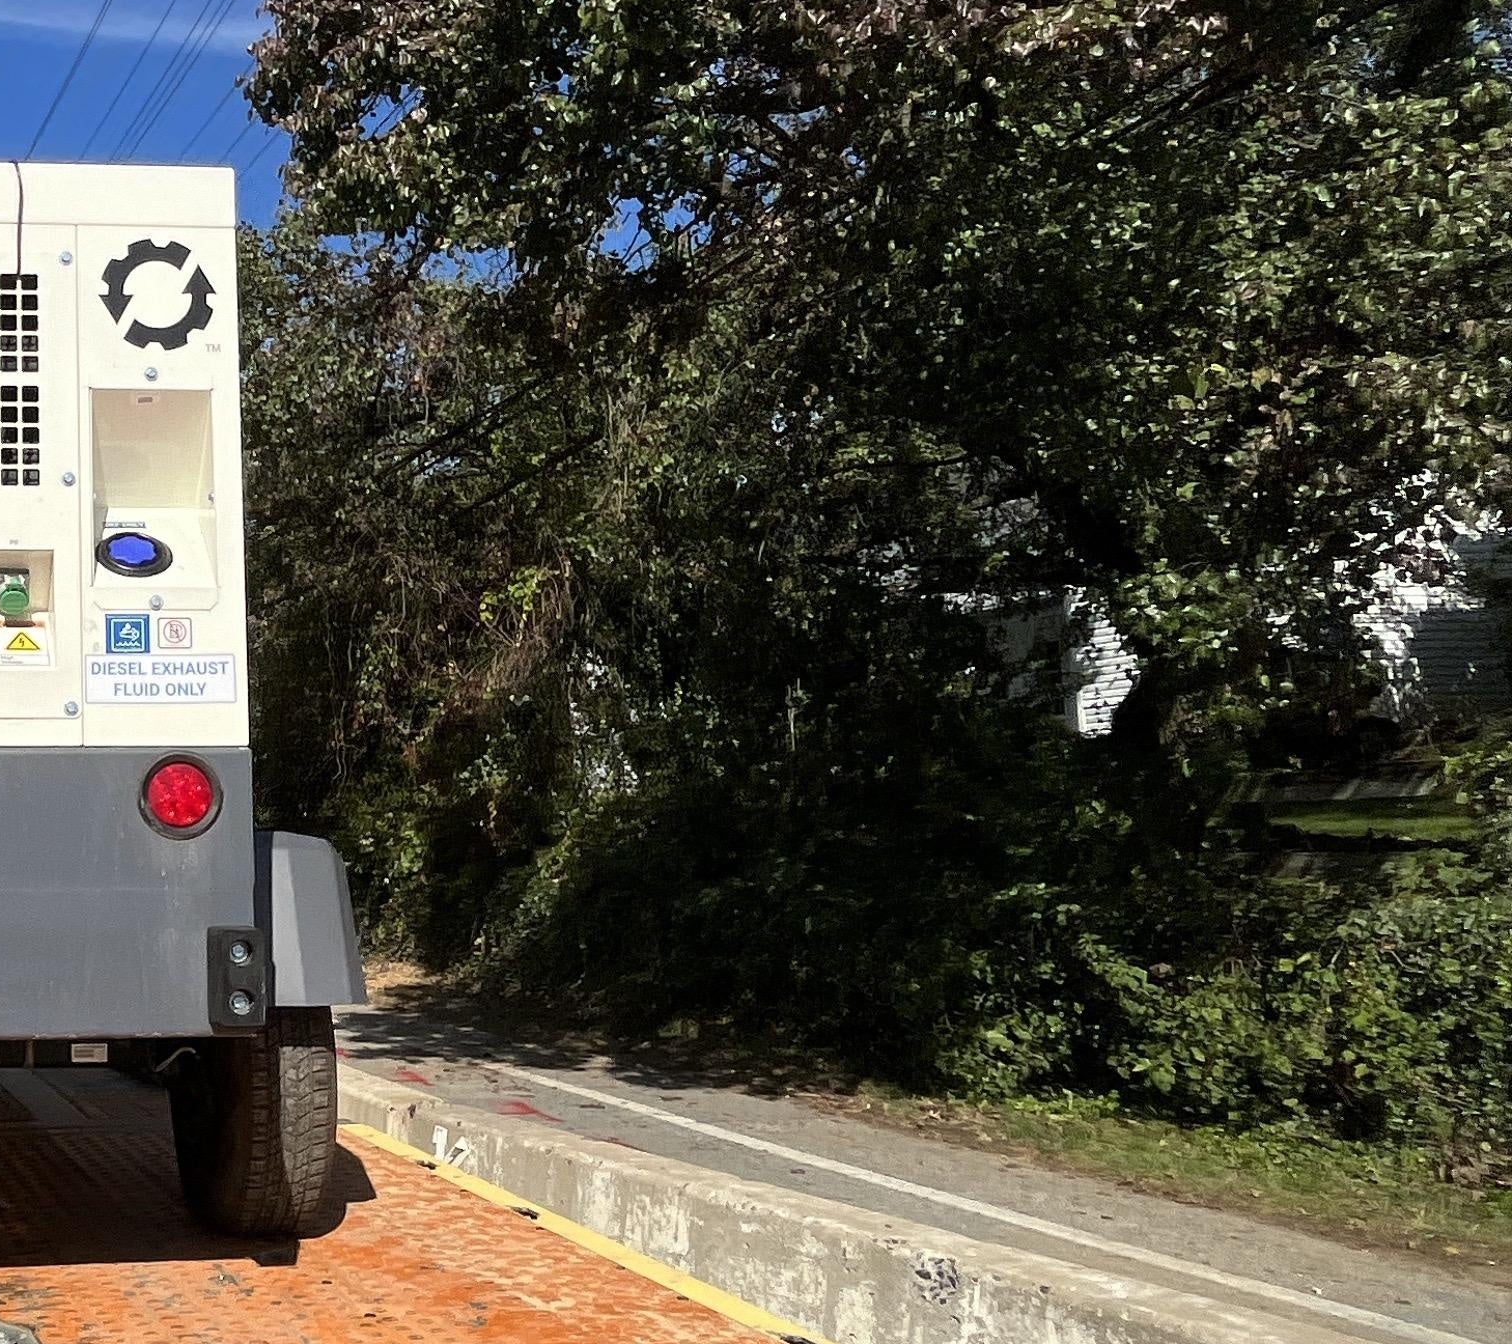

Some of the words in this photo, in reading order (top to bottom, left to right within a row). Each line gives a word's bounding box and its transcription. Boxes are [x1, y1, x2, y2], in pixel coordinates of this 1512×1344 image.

[205, 343, 221, 353] TM
[90, 661, 148, 675] DIESEL
[151, 660, 229, 675] EXHAUST
[113, 682, 160, 696] FLUID
[165, 682, 206, 696] ONLY
